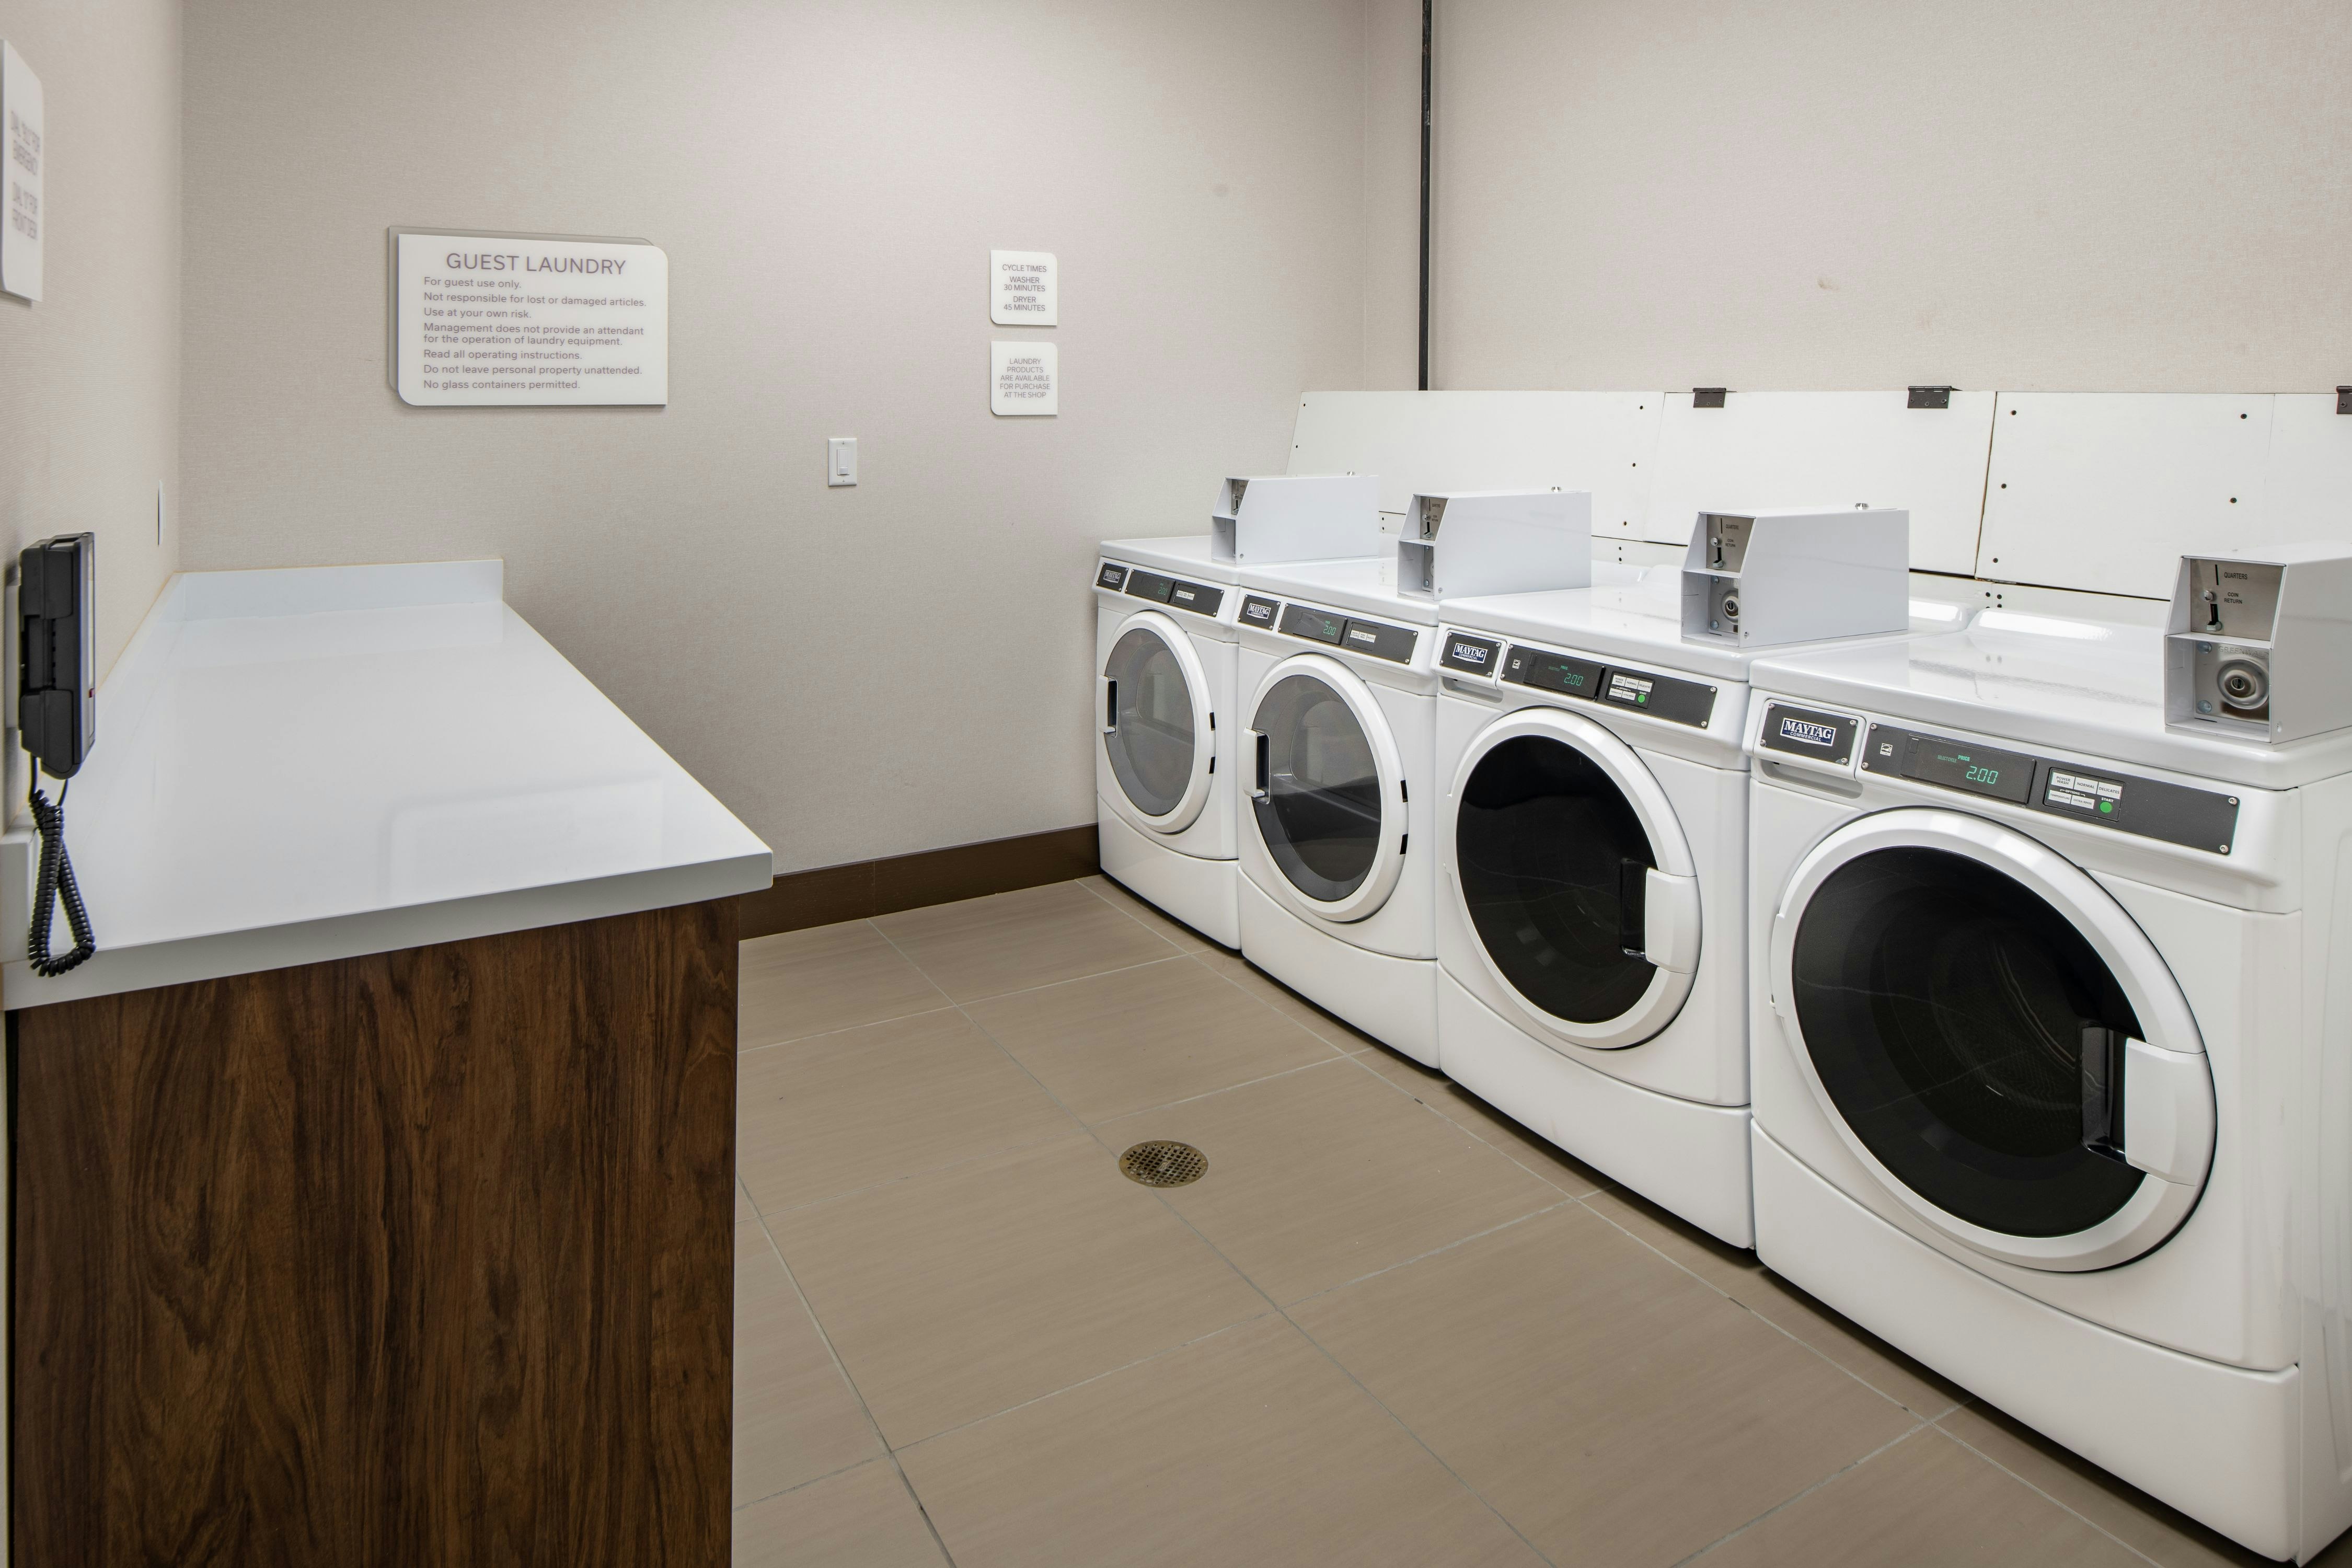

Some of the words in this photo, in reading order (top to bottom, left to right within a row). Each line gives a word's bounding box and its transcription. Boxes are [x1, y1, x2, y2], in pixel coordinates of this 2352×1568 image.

[447, 253, 519, 270] GUEST
[527, 256, 626, 274] LAUNDRY
[445, 279, 474, 287] guest
[498, 280, 521, 290] only.
[424, 292, 443, 301] Not
[447, 294, 506, 303] responsible
[561, 296, 606, 306] damaged
[424, 323, 493, 333] Management
[543, 326, 580, 335] provide
[423, 334, 439, 342] for
[442, 335, 458, 343] the
[462, 336, 511, 344] operation
[528, 336, 564, 346] laundry
[568, 337, 622, 346] equipment.
[468, 351, 517, 360] operating
[521, 351, 582, 359] instructions.
[492, 366, 535, 375] personal
[539, 366, 581, 375] property
[442, 381, 469, 390] glass
[529, 381, 580, 390] permitted.
[1249, 605, 1269, 615] MAYTAG
[1323, 625, 1336, 636] 2.00
[1456, 644, 1485, 658] MAYTAG
[1564, 673, 1584, 686] 2.00
[1784, 720, 1832, 739] MAYTAG
[1790, 731, 1821, 742] COMMERCIAL
[1966, 766, 1999, 785] 2.00
